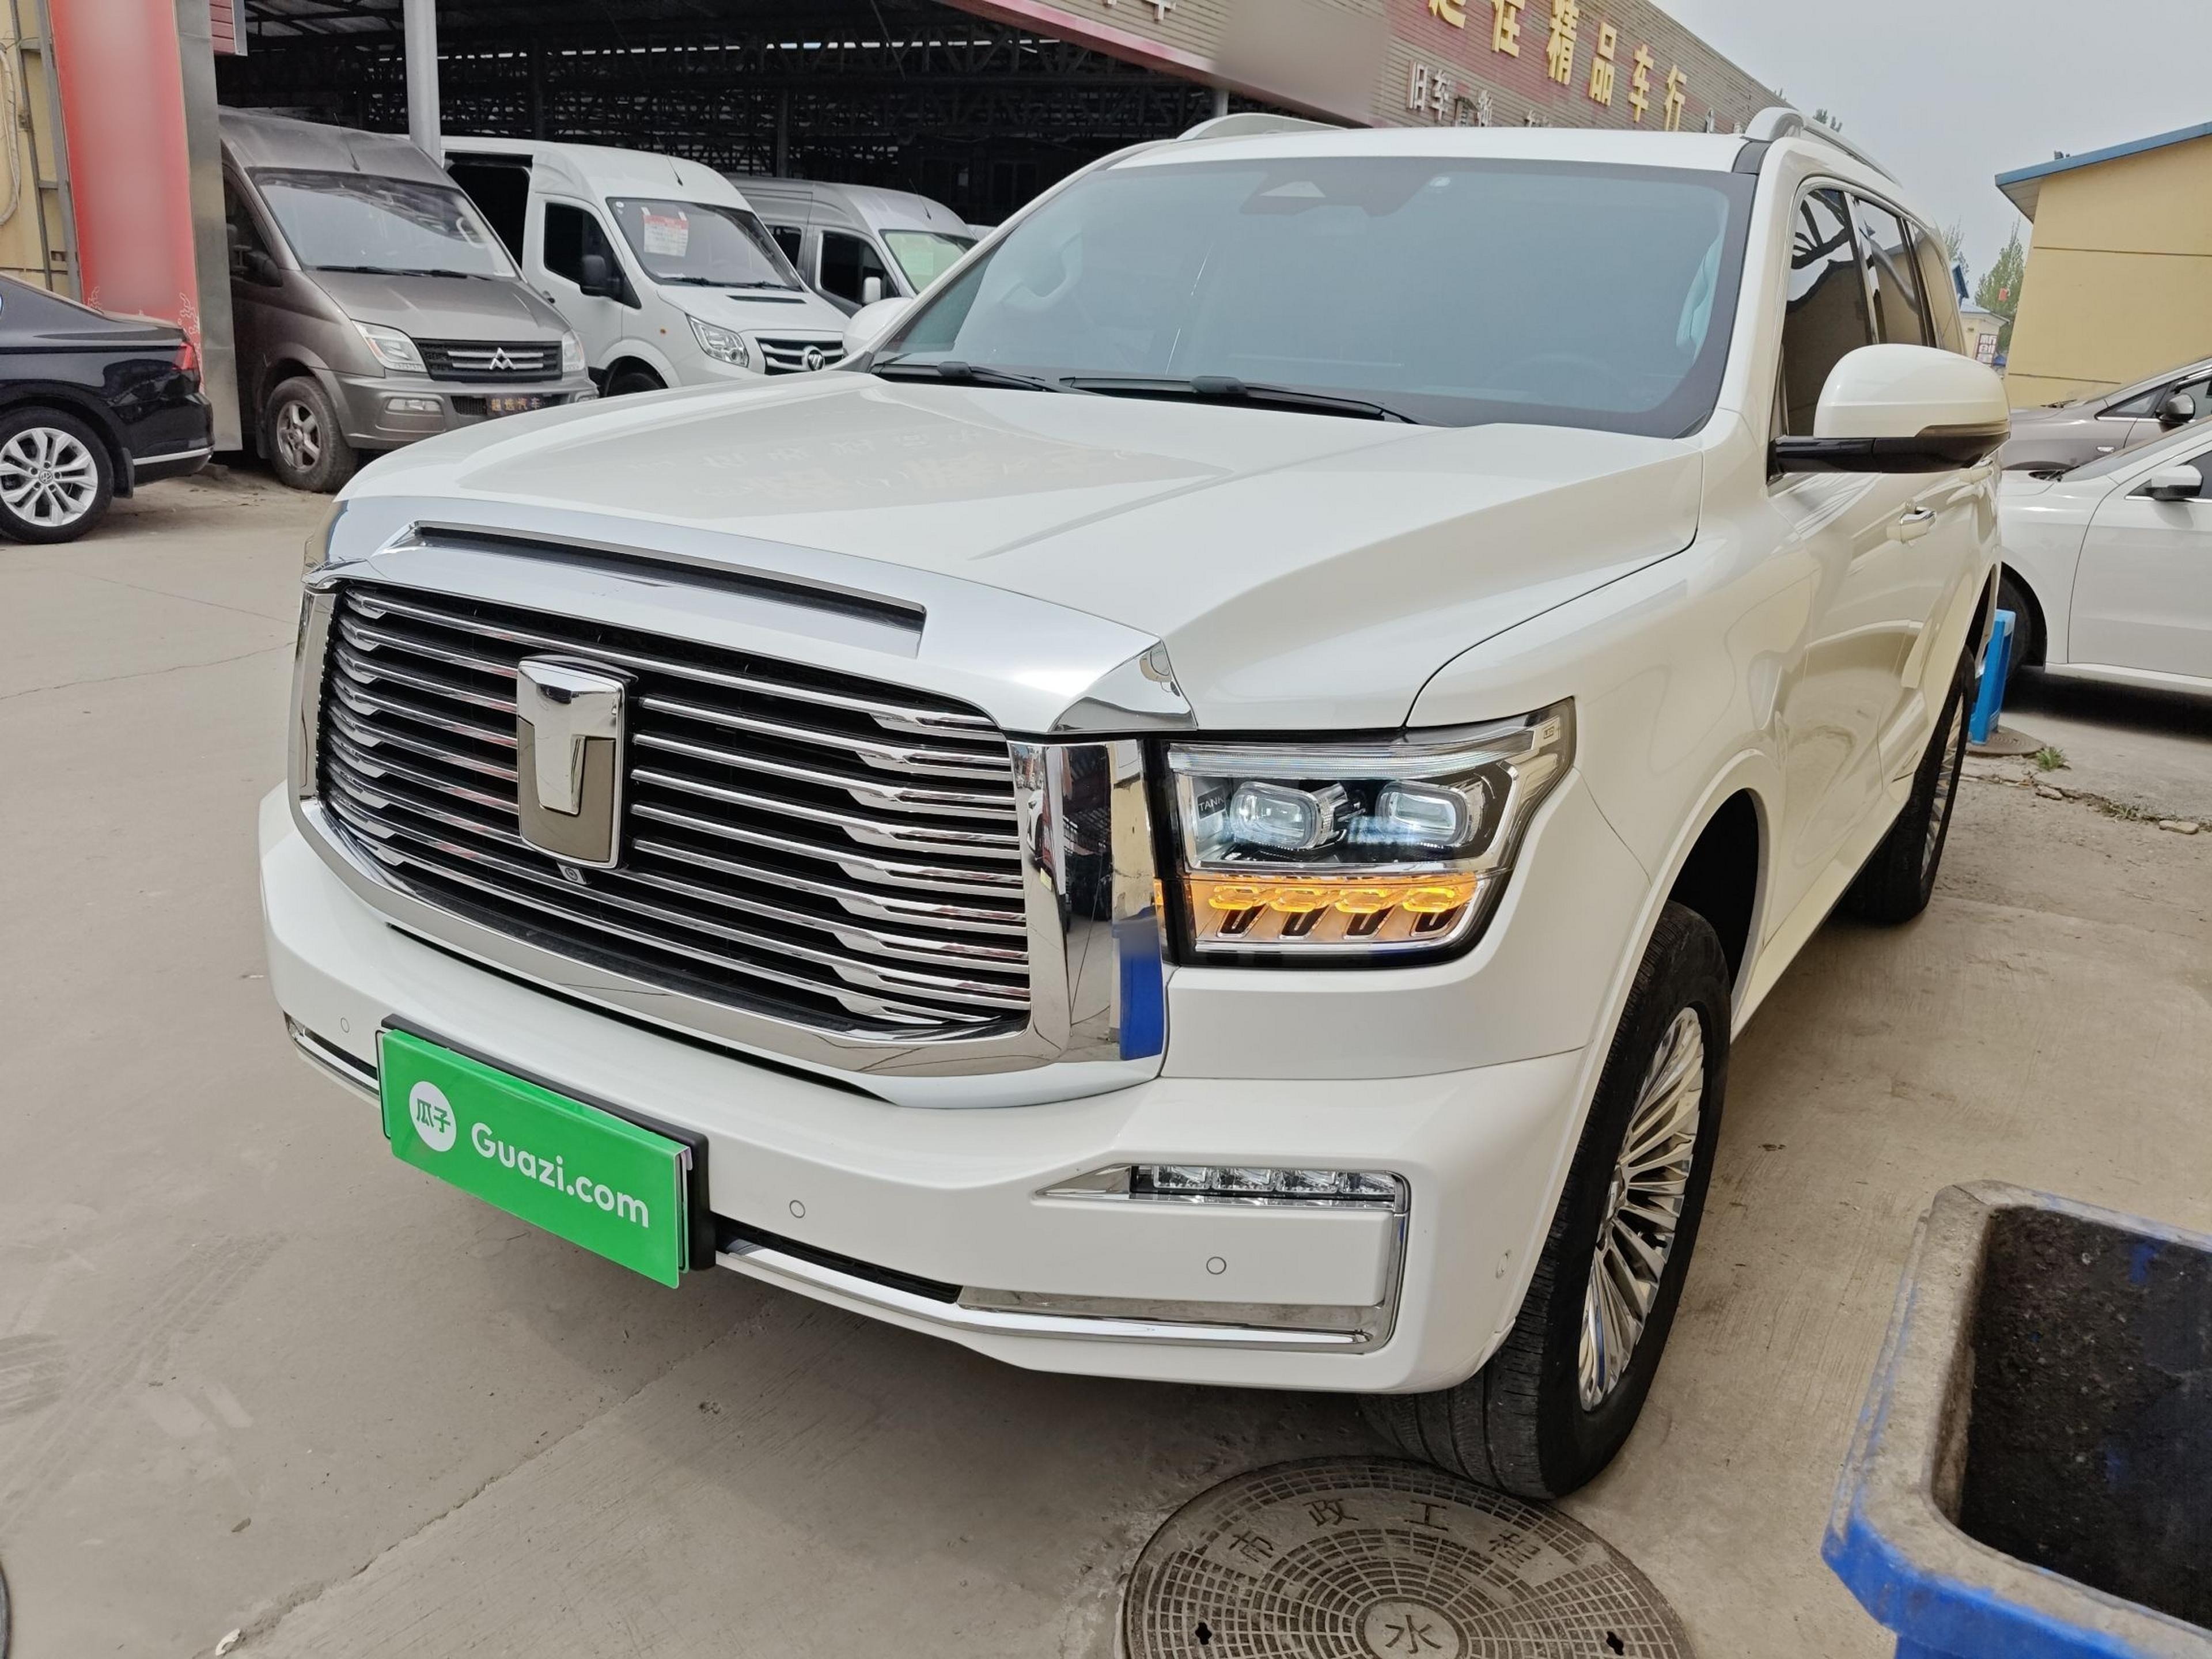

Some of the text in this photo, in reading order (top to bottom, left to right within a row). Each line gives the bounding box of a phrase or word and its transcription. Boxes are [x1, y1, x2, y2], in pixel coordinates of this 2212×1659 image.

[1198, 796, 1224, 812] TANK
[416, 1098, 450, 1133] 瓜子
[471, 1122, 649, 1228] Guazi.com
[1385, 1614, 1442, 1654] 水
